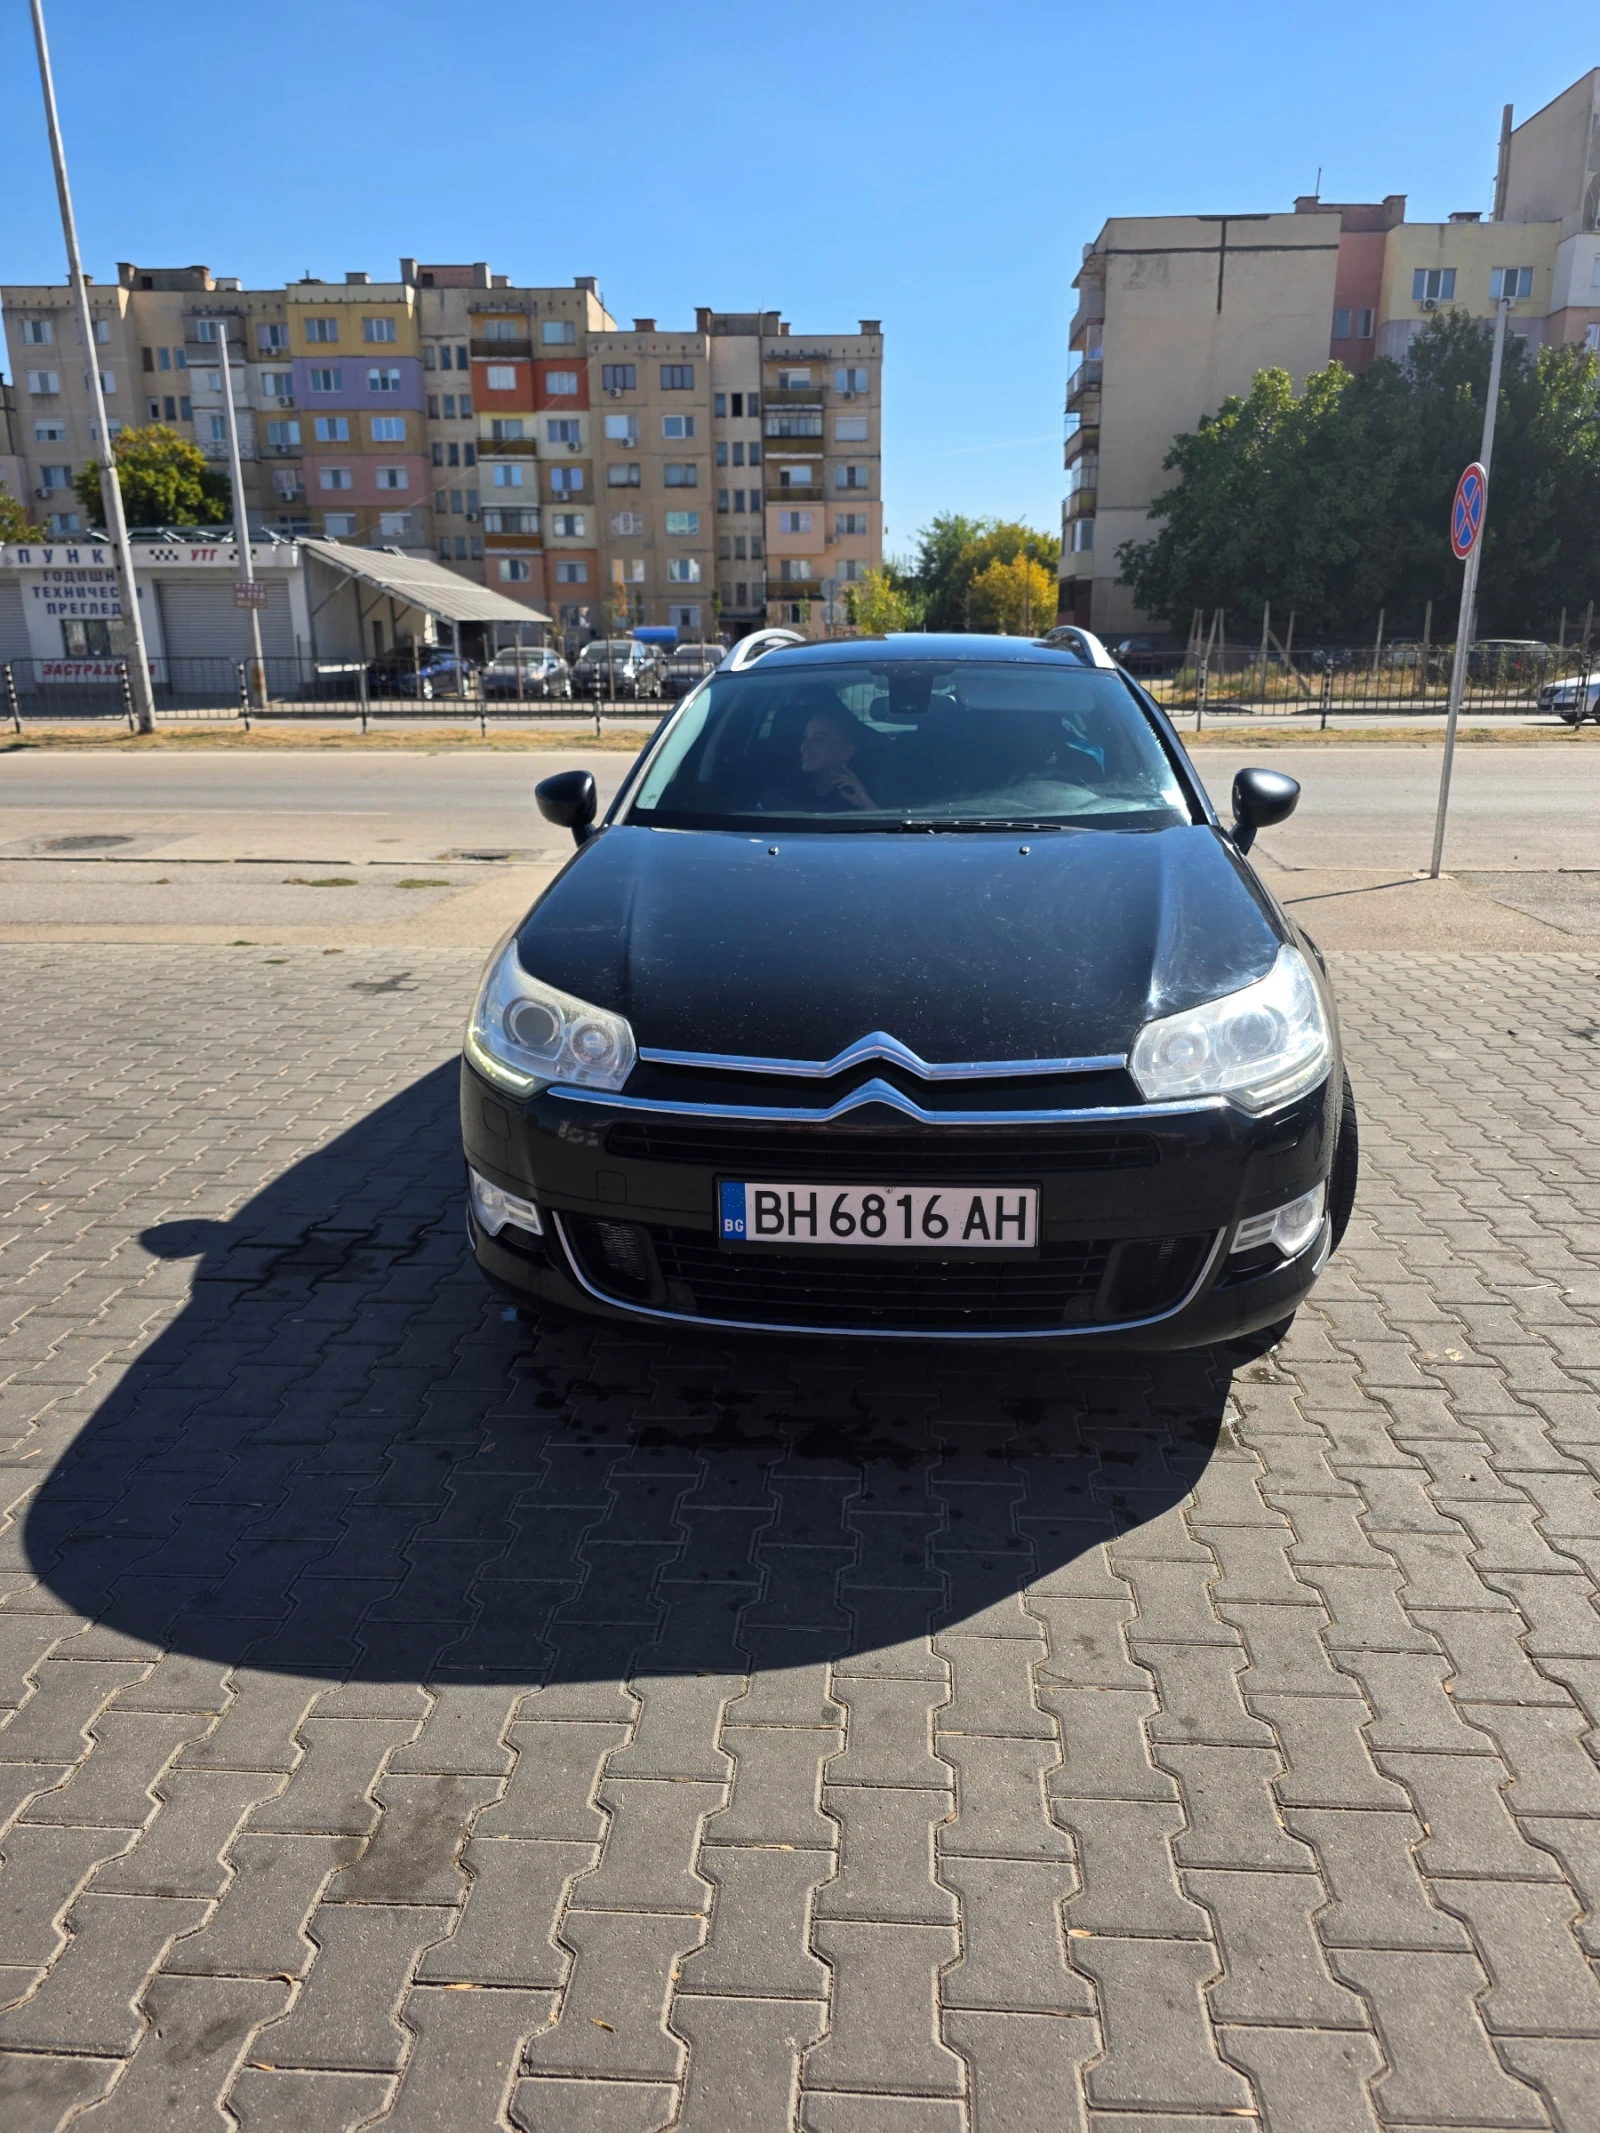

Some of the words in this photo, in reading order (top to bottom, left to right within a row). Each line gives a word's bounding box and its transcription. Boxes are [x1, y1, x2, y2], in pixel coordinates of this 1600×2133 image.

[18, 549, 105, 564] ПУНК
[190, 549, 218, 561] УТГ
[42, 571, 116, 584] ГОДИШН
[32, 586, 143, 599] ТЕХНИЧЕСИ
[46, 603, 122, 616] ПРЕГЛЕД
[829, 1193, 949, 1239] 6816
[724, 1218, 744, 1232] BG
